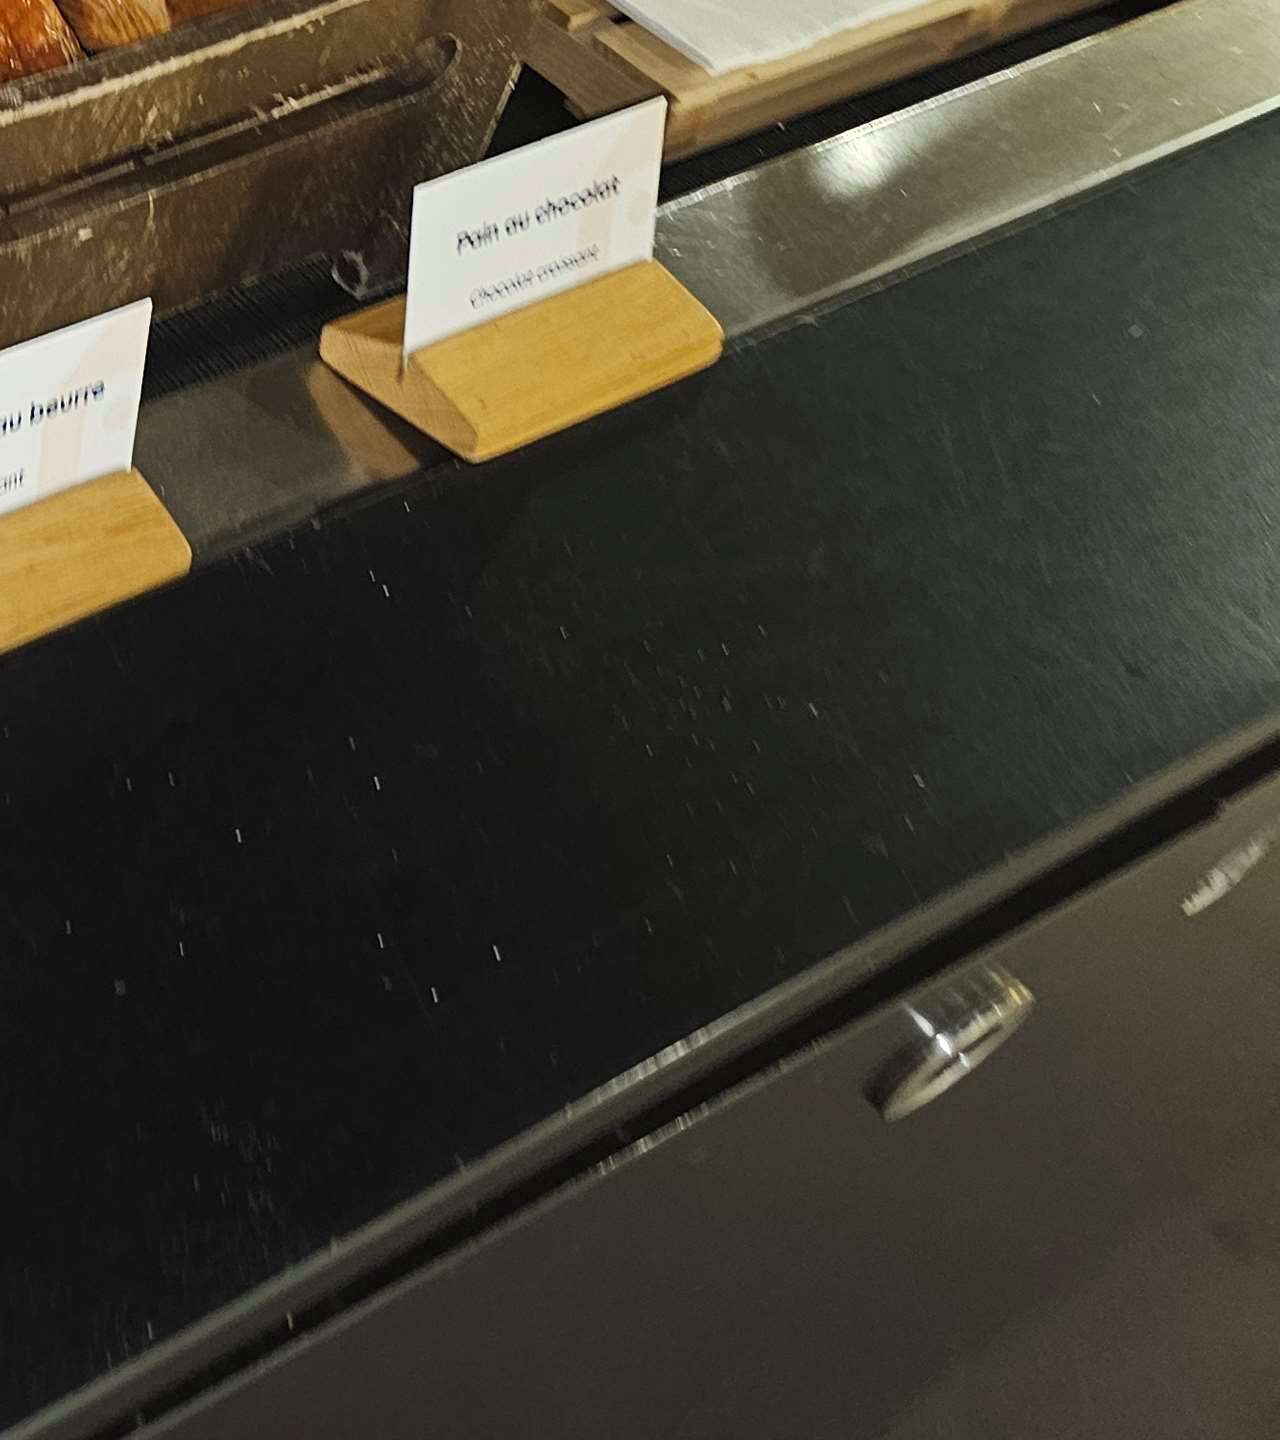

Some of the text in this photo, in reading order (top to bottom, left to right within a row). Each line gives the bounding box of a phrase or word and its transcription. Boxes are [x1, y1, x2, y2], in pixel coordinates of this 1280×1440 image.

[456, 173, 621, 257] Pain au chocolat
[29, 378, 106, 427] beurre
